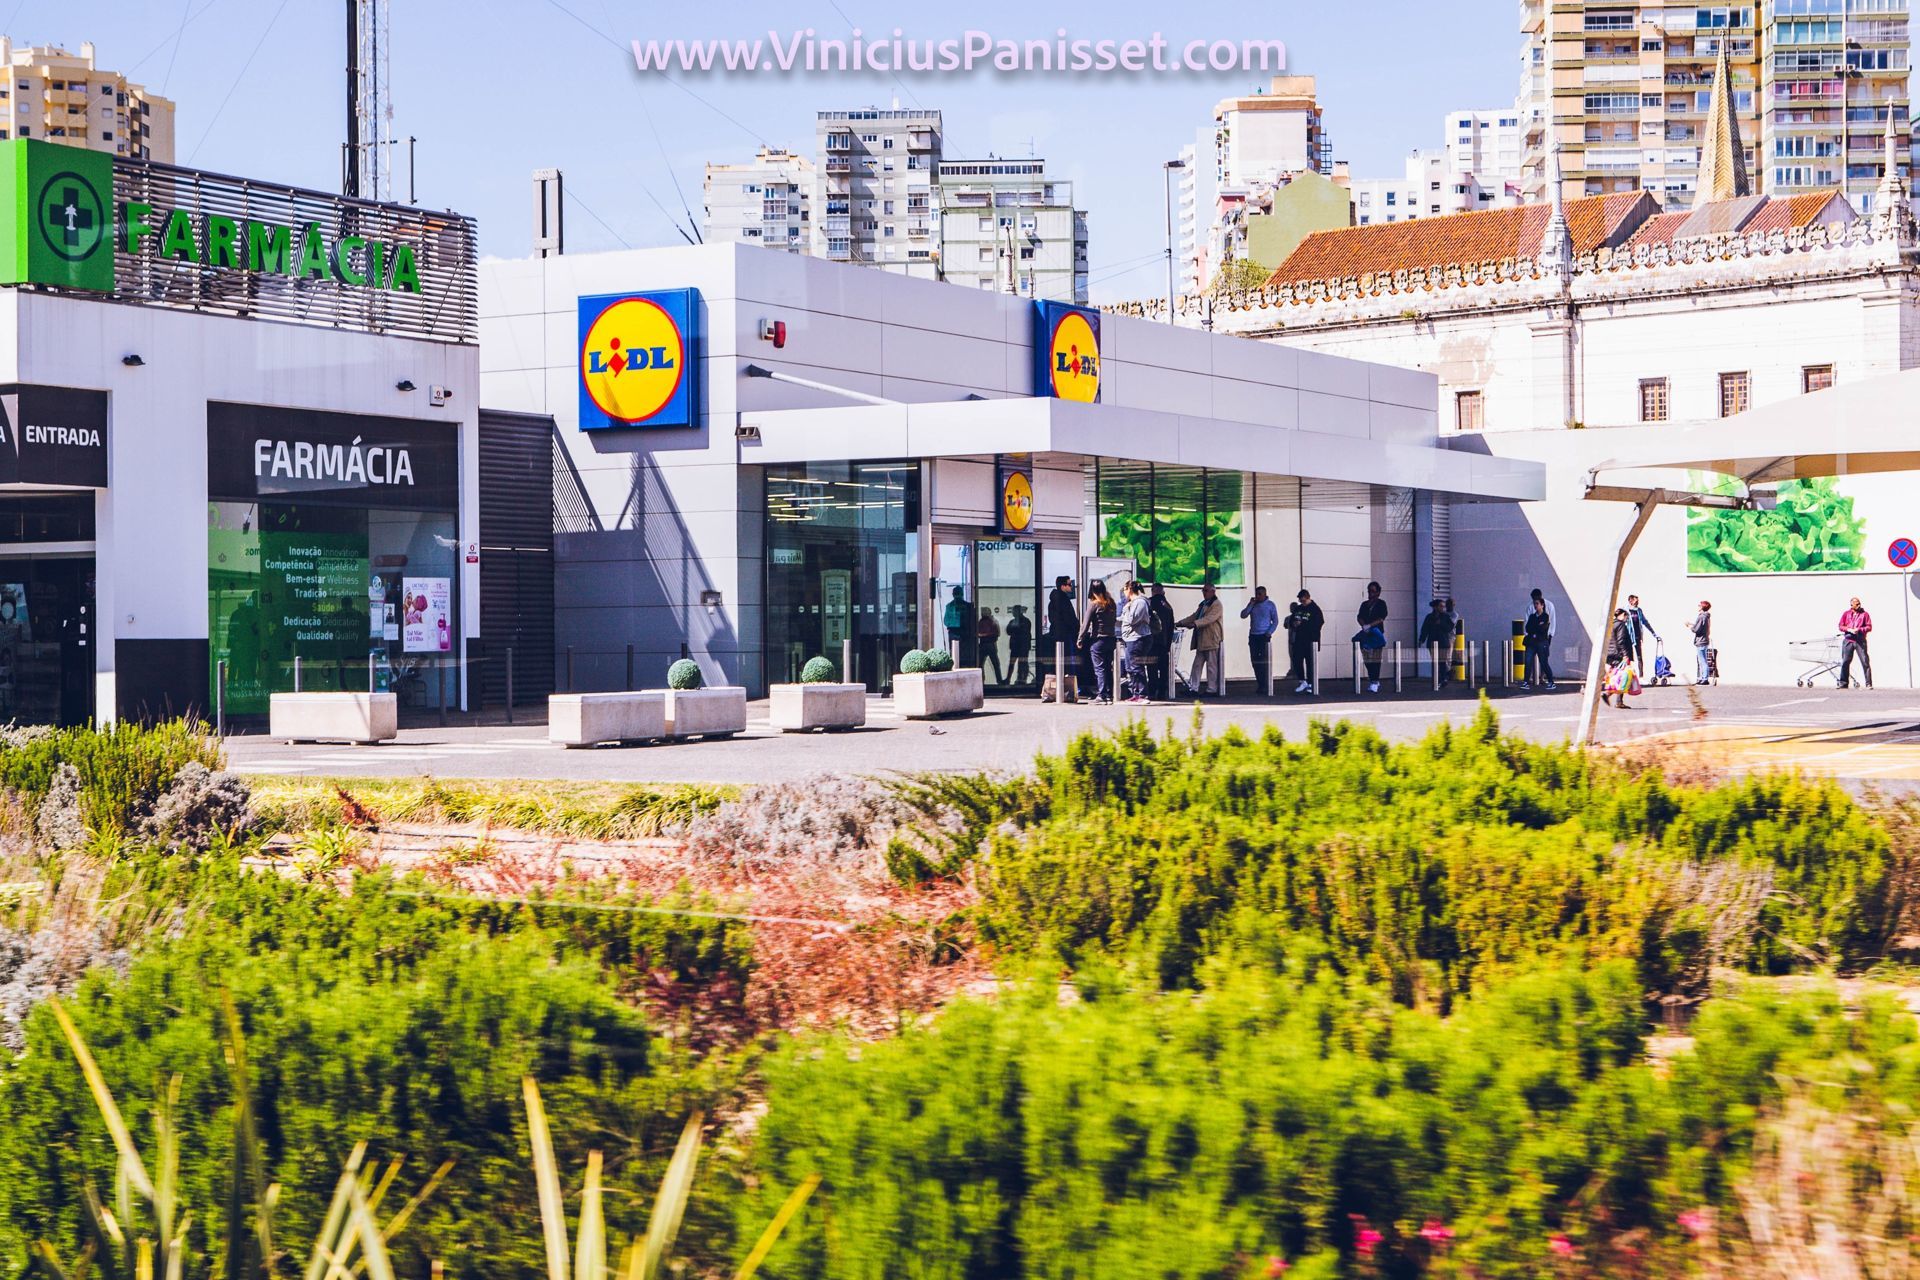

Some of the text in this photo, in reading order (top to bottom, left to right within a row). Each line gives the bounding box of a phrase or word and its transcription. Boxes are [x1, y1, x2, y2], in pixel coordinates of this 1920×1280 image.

[126, 201, 422, 294] FARMÁCIA
[26, 425, 100, 447] ENTRADA
[255, 434, 414, 485] FARMÁCIA
[289, 546, 322, 558] Inovação
[265, 559, 314, 571] Competência
[286, 574, 359, 585] Bem-estar Wellness
[294, 588, 327, 600] Tradição
[284, 616, 321, 628] Dedicação
[297, 631, 334, 640] Qualidade
